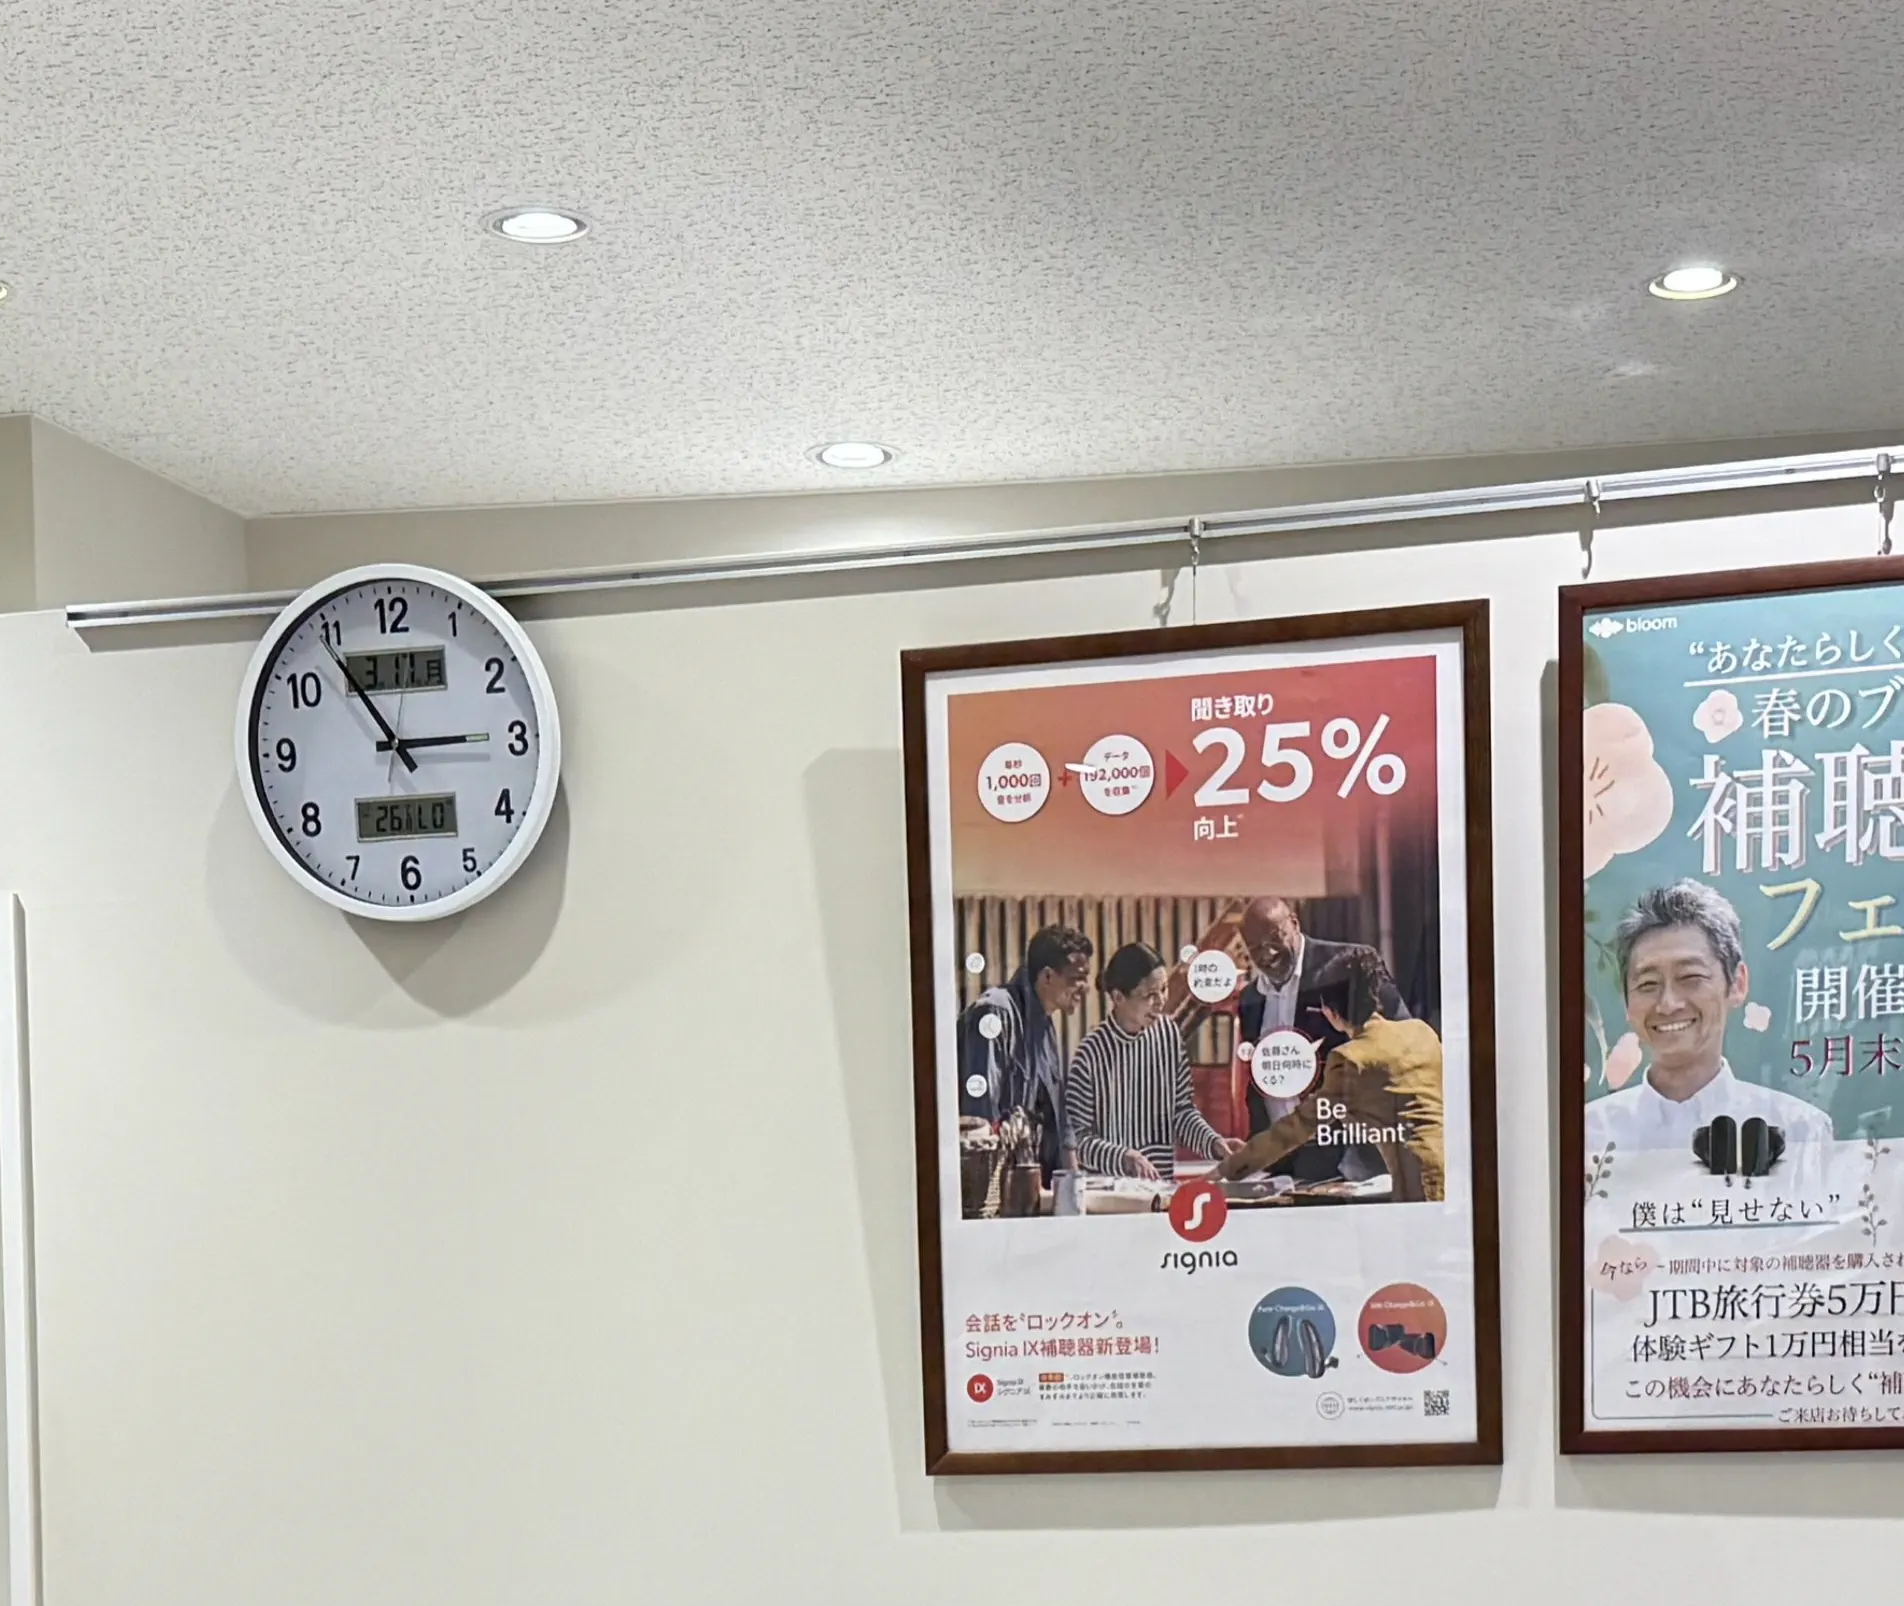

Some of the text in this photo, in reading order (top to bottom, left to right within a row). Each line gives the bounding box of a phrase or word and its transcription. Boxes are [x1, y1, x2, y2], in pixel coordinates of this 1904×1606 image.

[374, 597, 410, 634] 12
[448, 612, 458, 637] 1
[1626, 615, 1678, 632] bloom
[321, 620, 342, 646] 11
[484, 658, 506, 694] 2
[287, 672, 323, 709] 10
[1191, 692, 1275, 722] 聞き取り
[508, 720, 529, 756] 3
[276, 738, 297, 773] 9
[1192, 713, 1407, 808] 25%
[985, 773, 1043, 792] 1,000回
[301, 802, 322, 837] 8
[494, 788, 515, 824] 4
[1193, 815, 1239, 842] 向上
[346, 855, 361, 881] 7
[400, 855, 422, 891] 6
[462, 847, 478, 873] 5
[1316, 1097, 1347, 1120] Be
[1316, 1123, 1406, 1147] Brilliant
[1160, 1250, 1238, 1276] signia
[1599, 1257, 1648, 1282] 今なら
